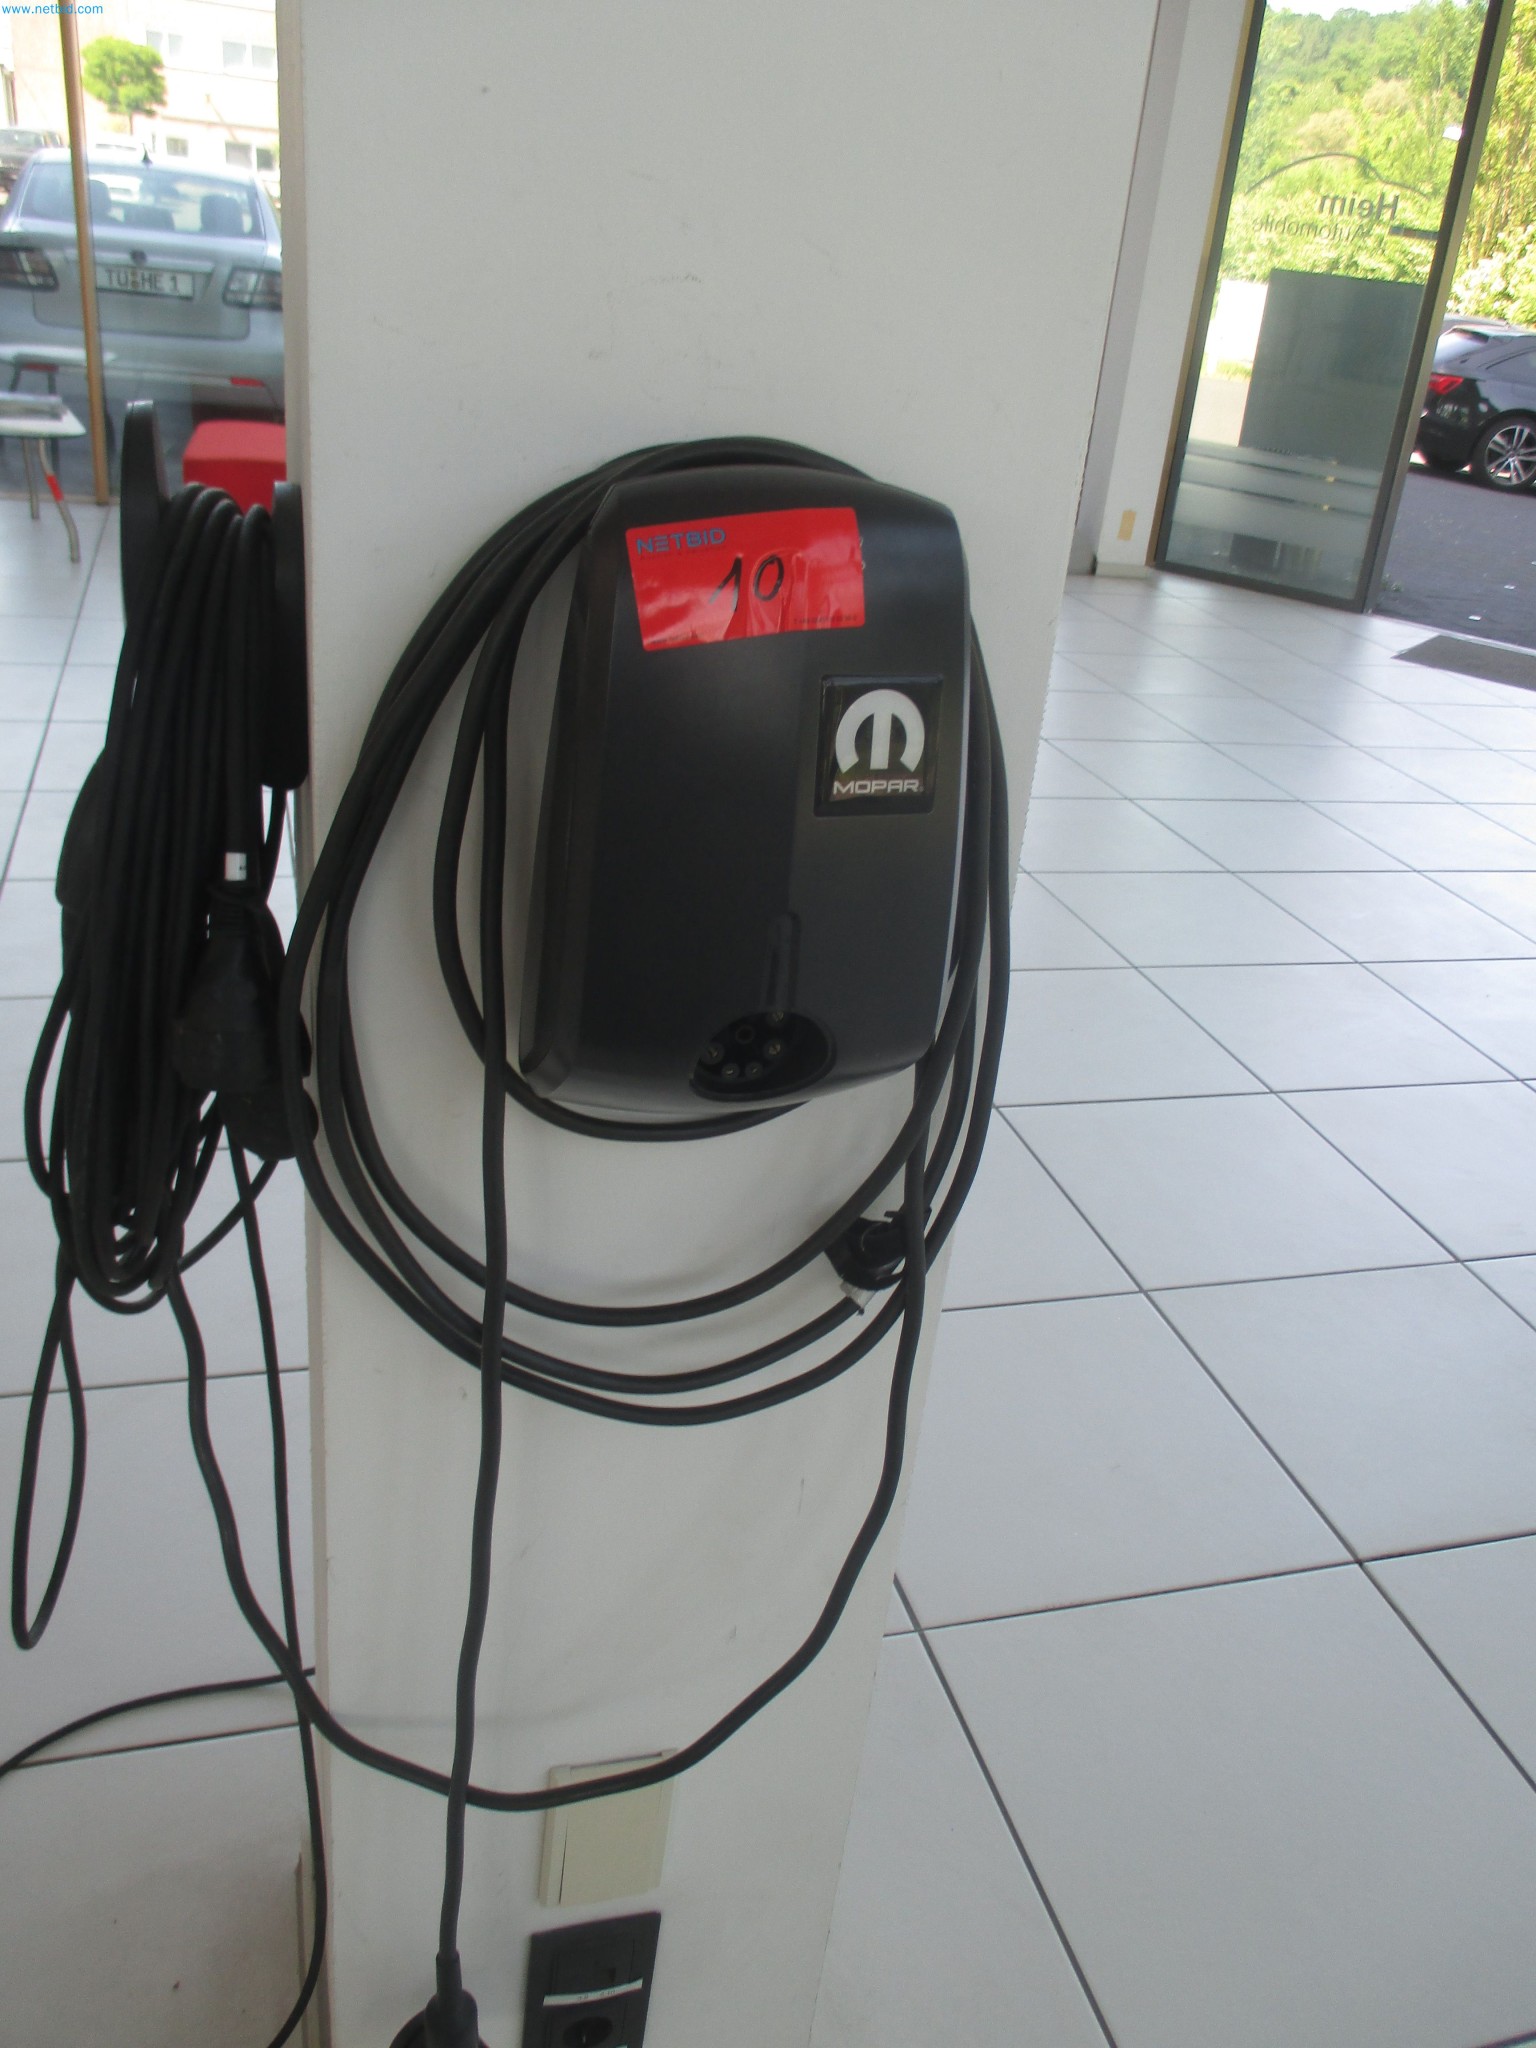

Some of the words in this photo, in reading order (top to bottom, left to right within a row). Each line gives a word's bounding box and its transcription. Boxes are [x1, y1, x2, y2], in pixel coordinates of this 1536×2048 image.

[636, 527, 726, 555] NETBID
[708, 554, 784, 613] 10
[833, 779, 921, 795] MOPAR
